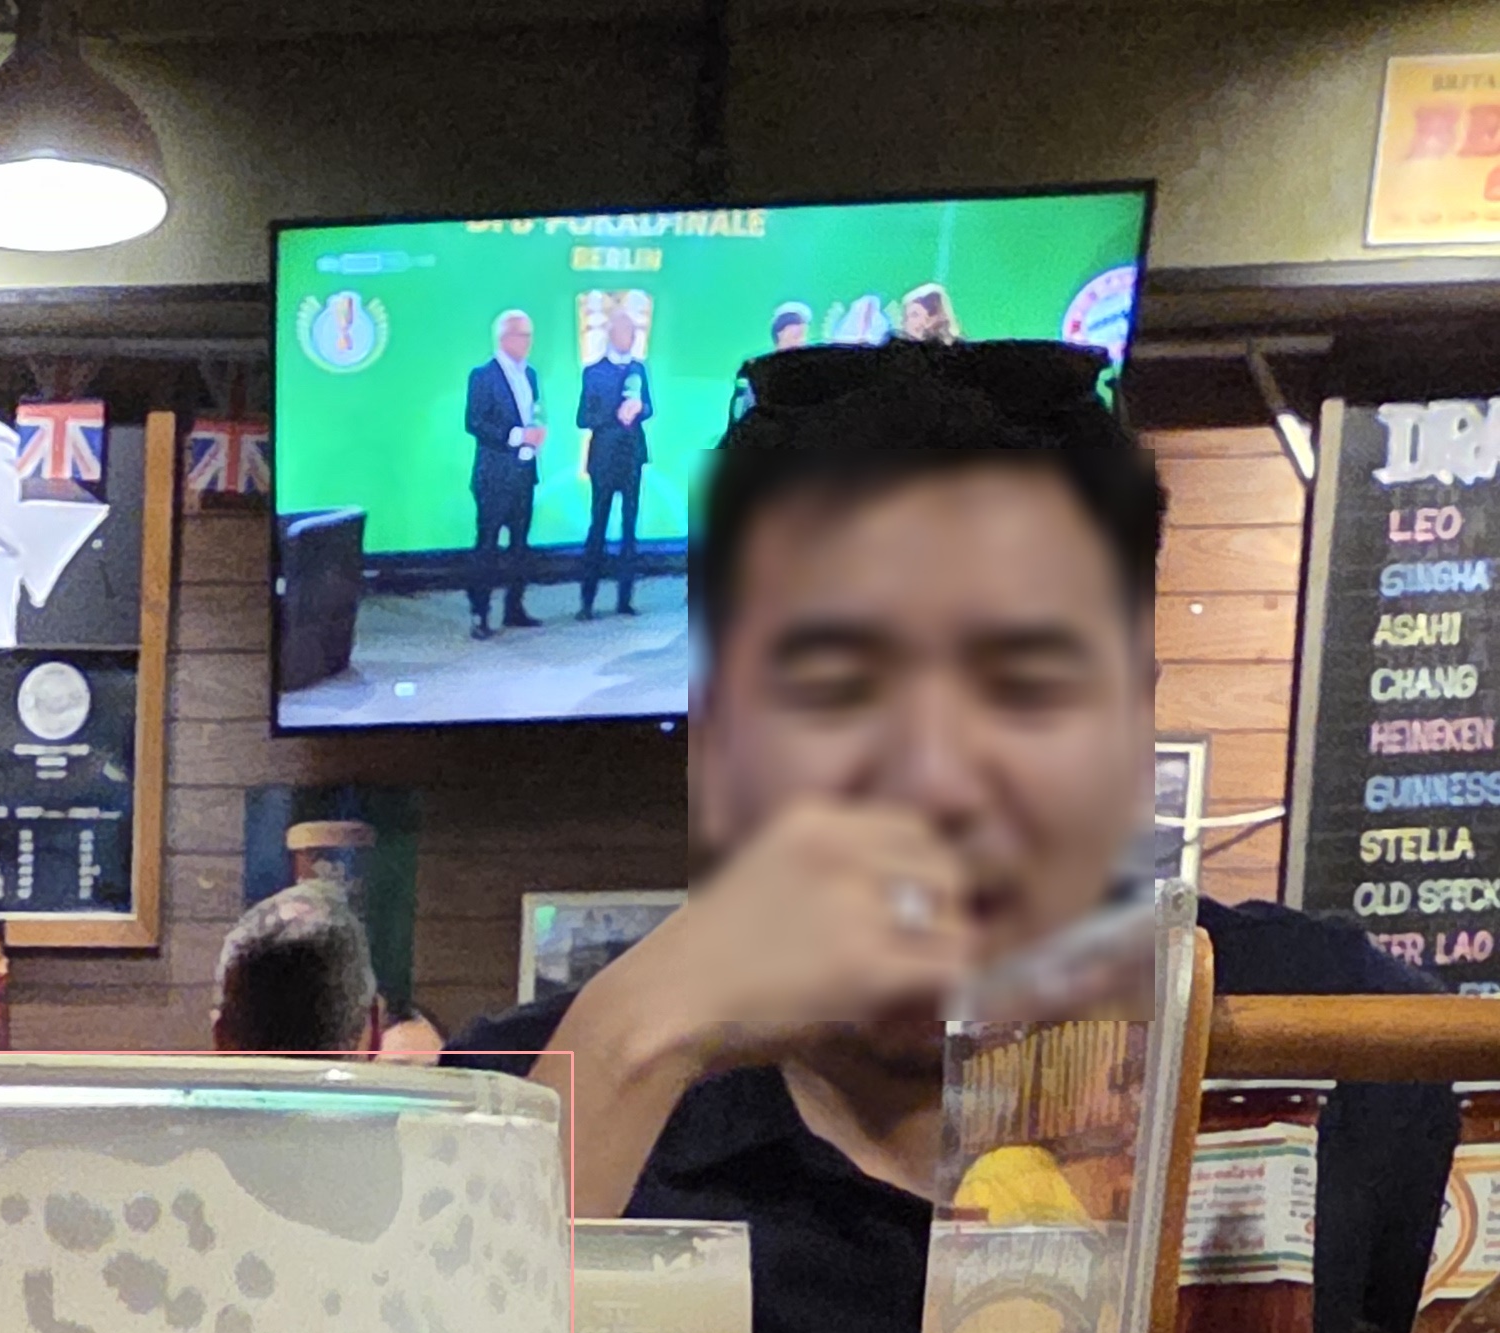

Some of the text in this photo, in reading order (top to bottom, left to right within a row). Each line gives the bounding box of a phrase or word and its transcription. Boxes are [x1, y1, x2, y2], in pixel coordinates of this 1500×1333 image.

[1389, 505, 1462, 541] LEO
[1380, 560, 1490, 597] SINGHA
[1373, 612, 1461, 647] ASAHI
[1371, 664, 1478, 702] CHANG
[1370, 717, 1495, 754] HEINEKEN
[1364, 771, 1500, 813] GUINNESS
[1360, 827, 1475, 863] STELLA
[1353, 881, 1412, 916] OLD
[1435, 930, 1493, 965] LAO
